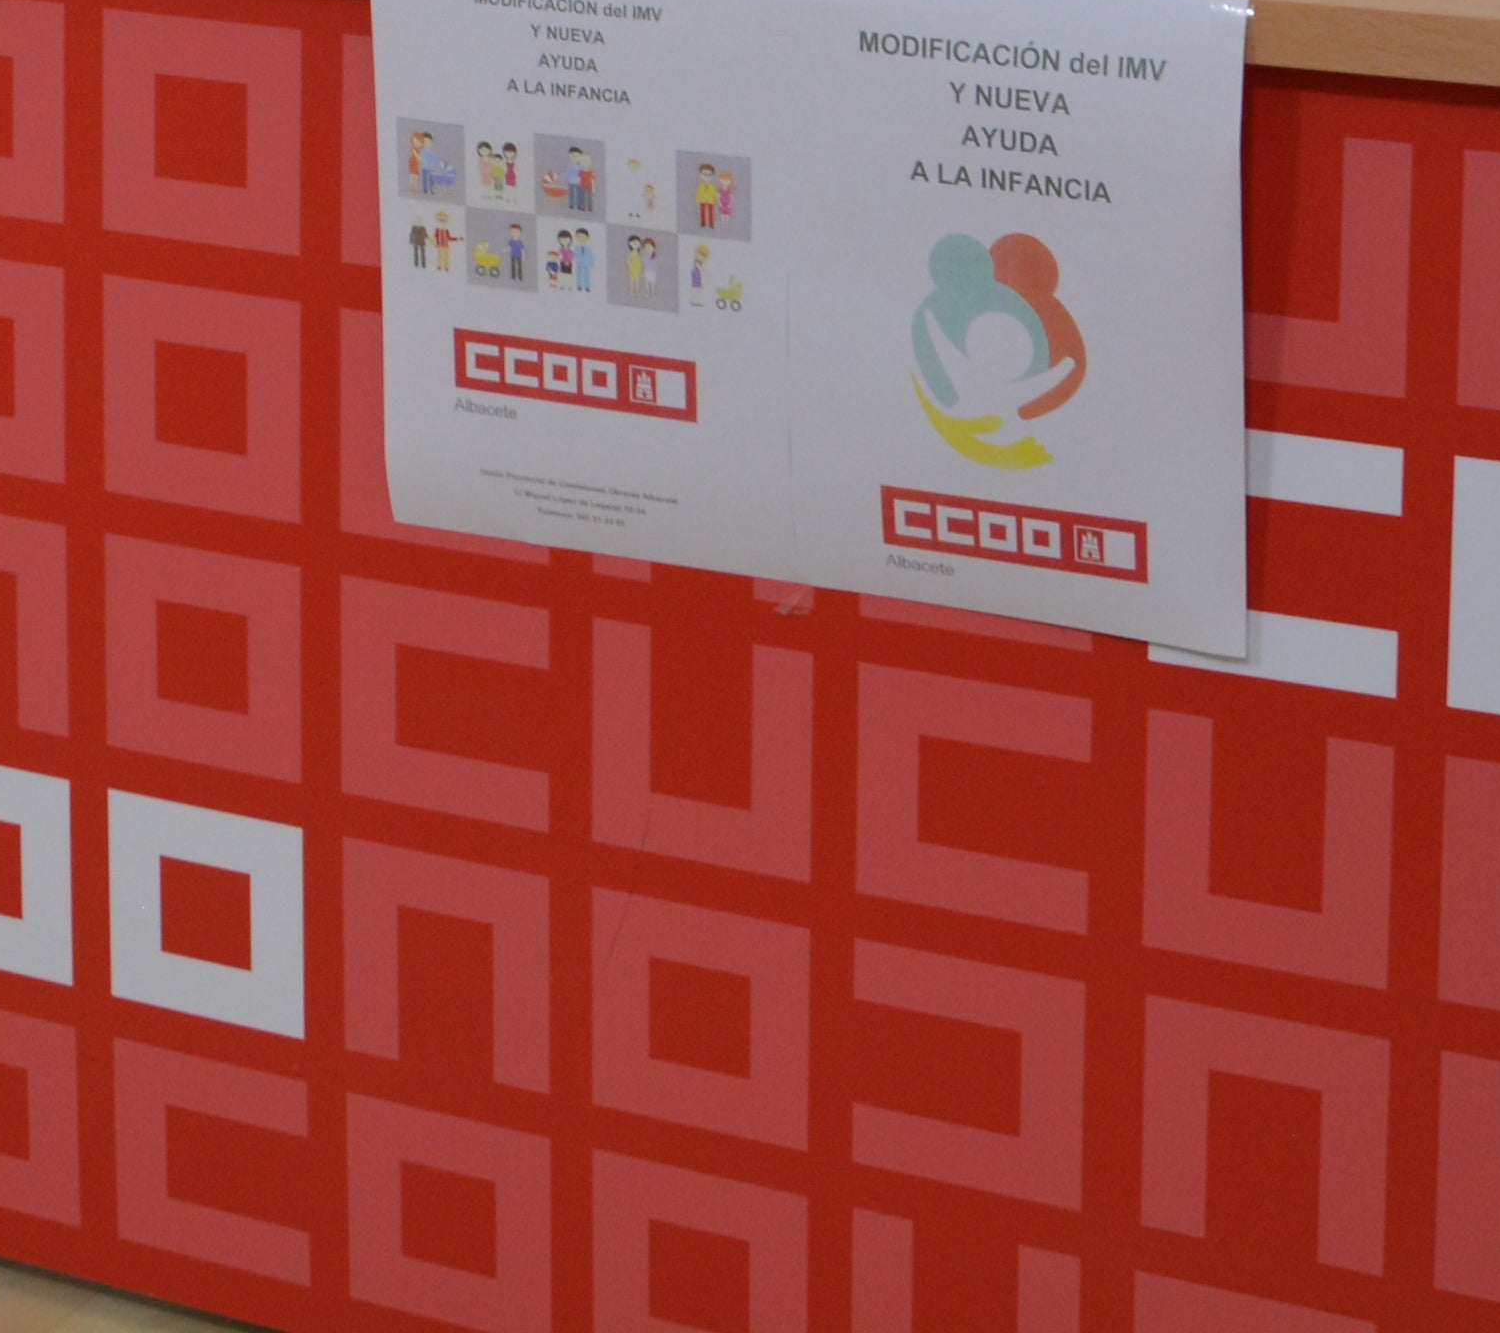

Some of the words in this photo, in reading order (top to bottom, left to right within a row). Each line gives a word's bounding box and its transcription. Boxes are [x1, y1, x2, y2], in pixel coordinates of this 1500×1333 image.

[603, 2, 628, 19] del
[632, 4, 662, 22] IMV
[531, 25, 542, 39] Y
[547, 27, 606, 45] NUEVA
[538, 54, 598, 73] AYUDA
[858, 30, 1060, 72] MODIFICACIÓN
[1069, 52, 1108, 77] del
[1117, 55, 1167, 81] IMV
[507, 79, 519, 93] A
[523, 81, 547, 96] LA
[550, 83, 631, 105] INFANCIA
[949, 81, 966, 105] Y
[975, 85, 1070, 116] NUEVA
[961, 125, 1058, 157] AYUDA
[910, 160, 929, 183] A
[938, 164, 972, 188] LA
[981, 167, 1112, 204] INFANCIA
[465, 341, 617, 400] CCOO
[455, 398, 517, 420] Albacete
[893, 498, 1062, 560] CCOO
[886, 554, 954, 577] Albacete
